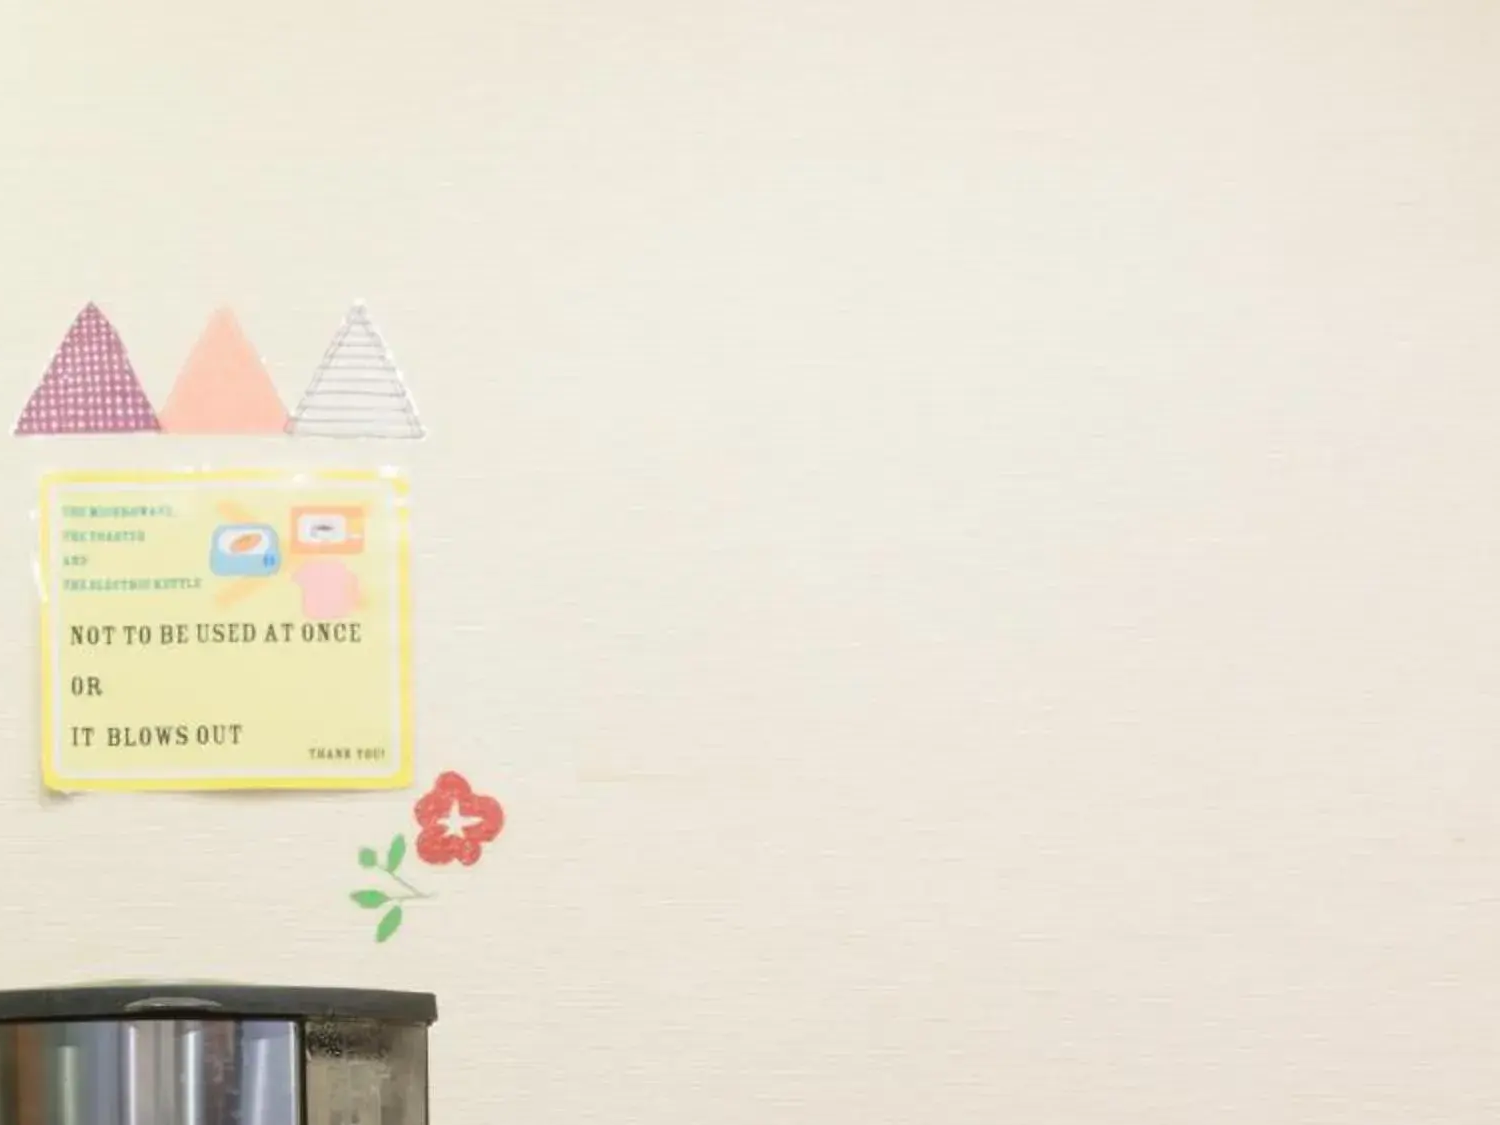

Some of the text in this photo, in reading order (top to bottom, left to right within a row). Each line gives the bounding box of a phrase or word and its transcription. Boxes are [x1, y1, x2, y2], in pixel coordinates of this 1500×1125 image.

[71, 622, 362, 645] NOT TO BE USED AT ONCE
[71, 675, 103, 696] OR
[71, 724, 243, 747] IT BLOWS OUT
[308, 748, 386, 760] THANK YOU!
